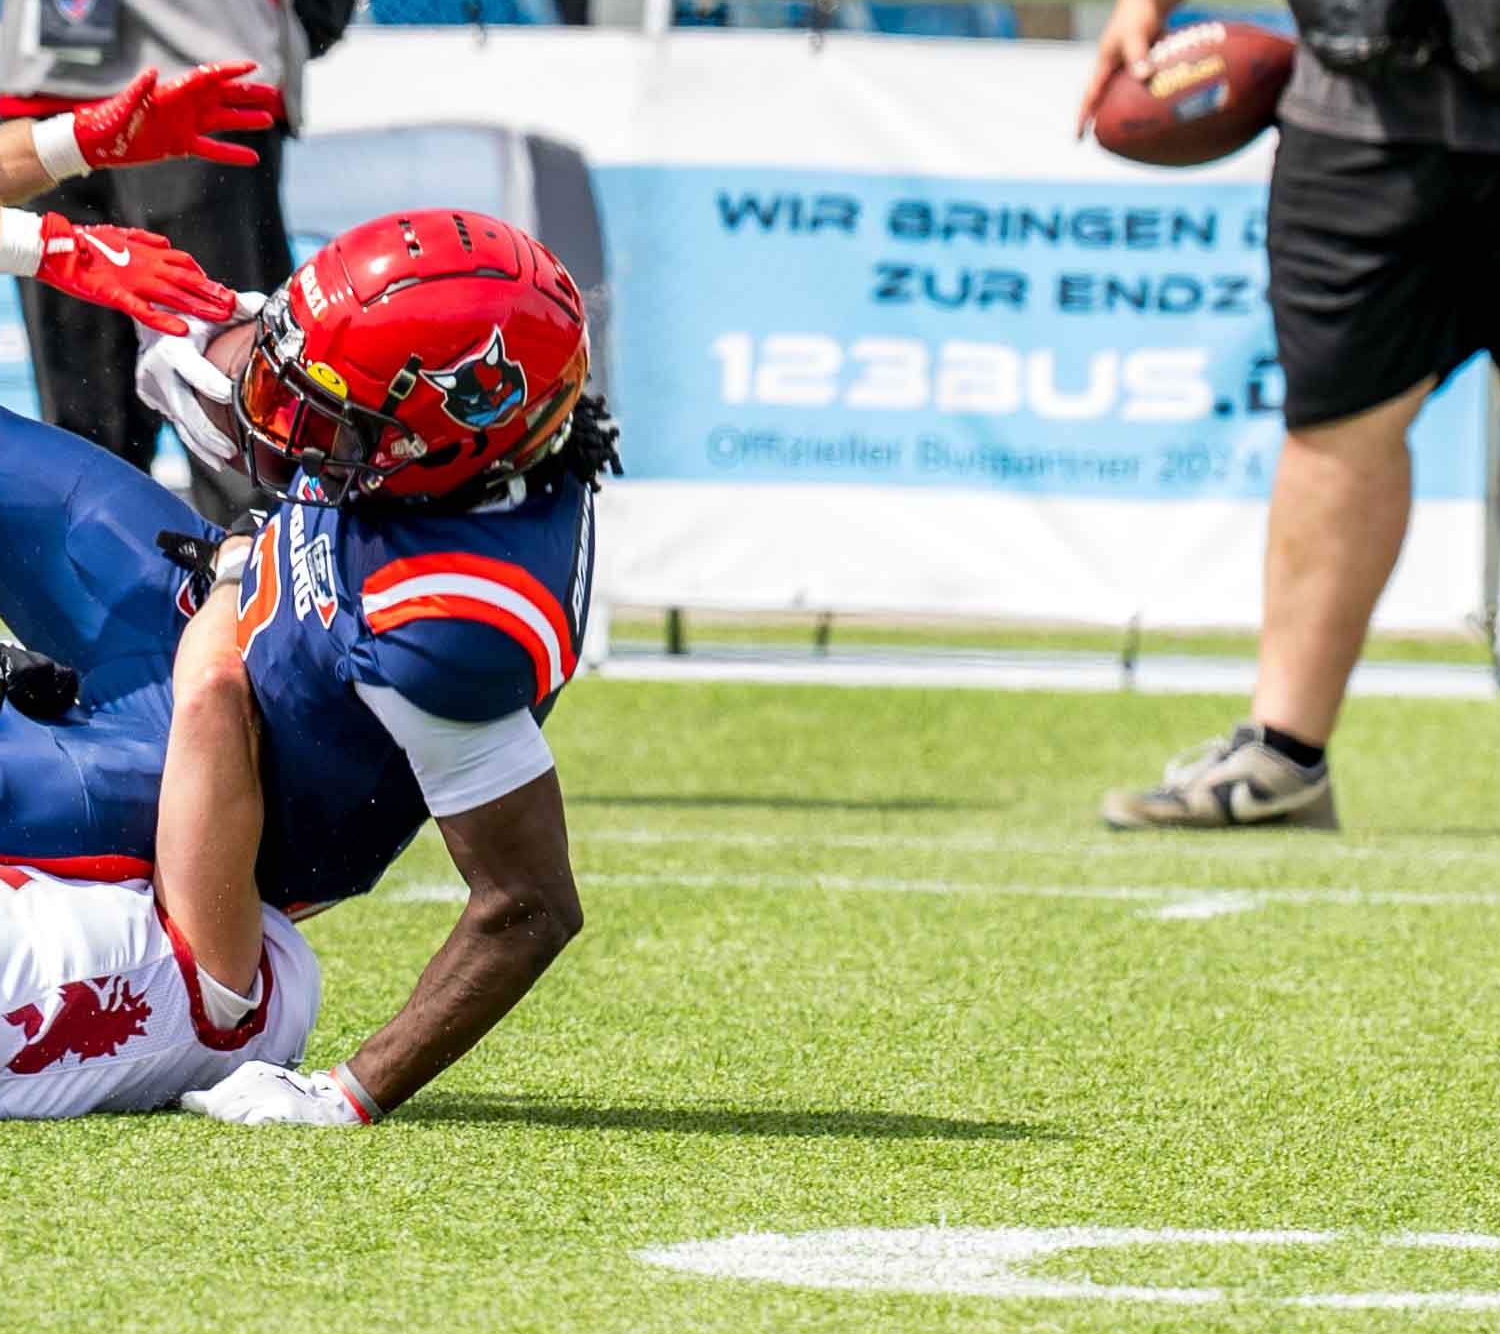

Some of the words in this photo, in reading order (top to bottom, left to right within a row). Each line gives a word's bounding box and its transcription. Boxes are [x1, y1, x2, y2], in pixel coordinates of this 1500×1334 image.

[716, 192, 861, 235] WIR
[887, 198, 1216, 250] BRINGEN
[872, 263, 1029, 311] ZUR
[1057, 273, 1268, 314] ENDZ
